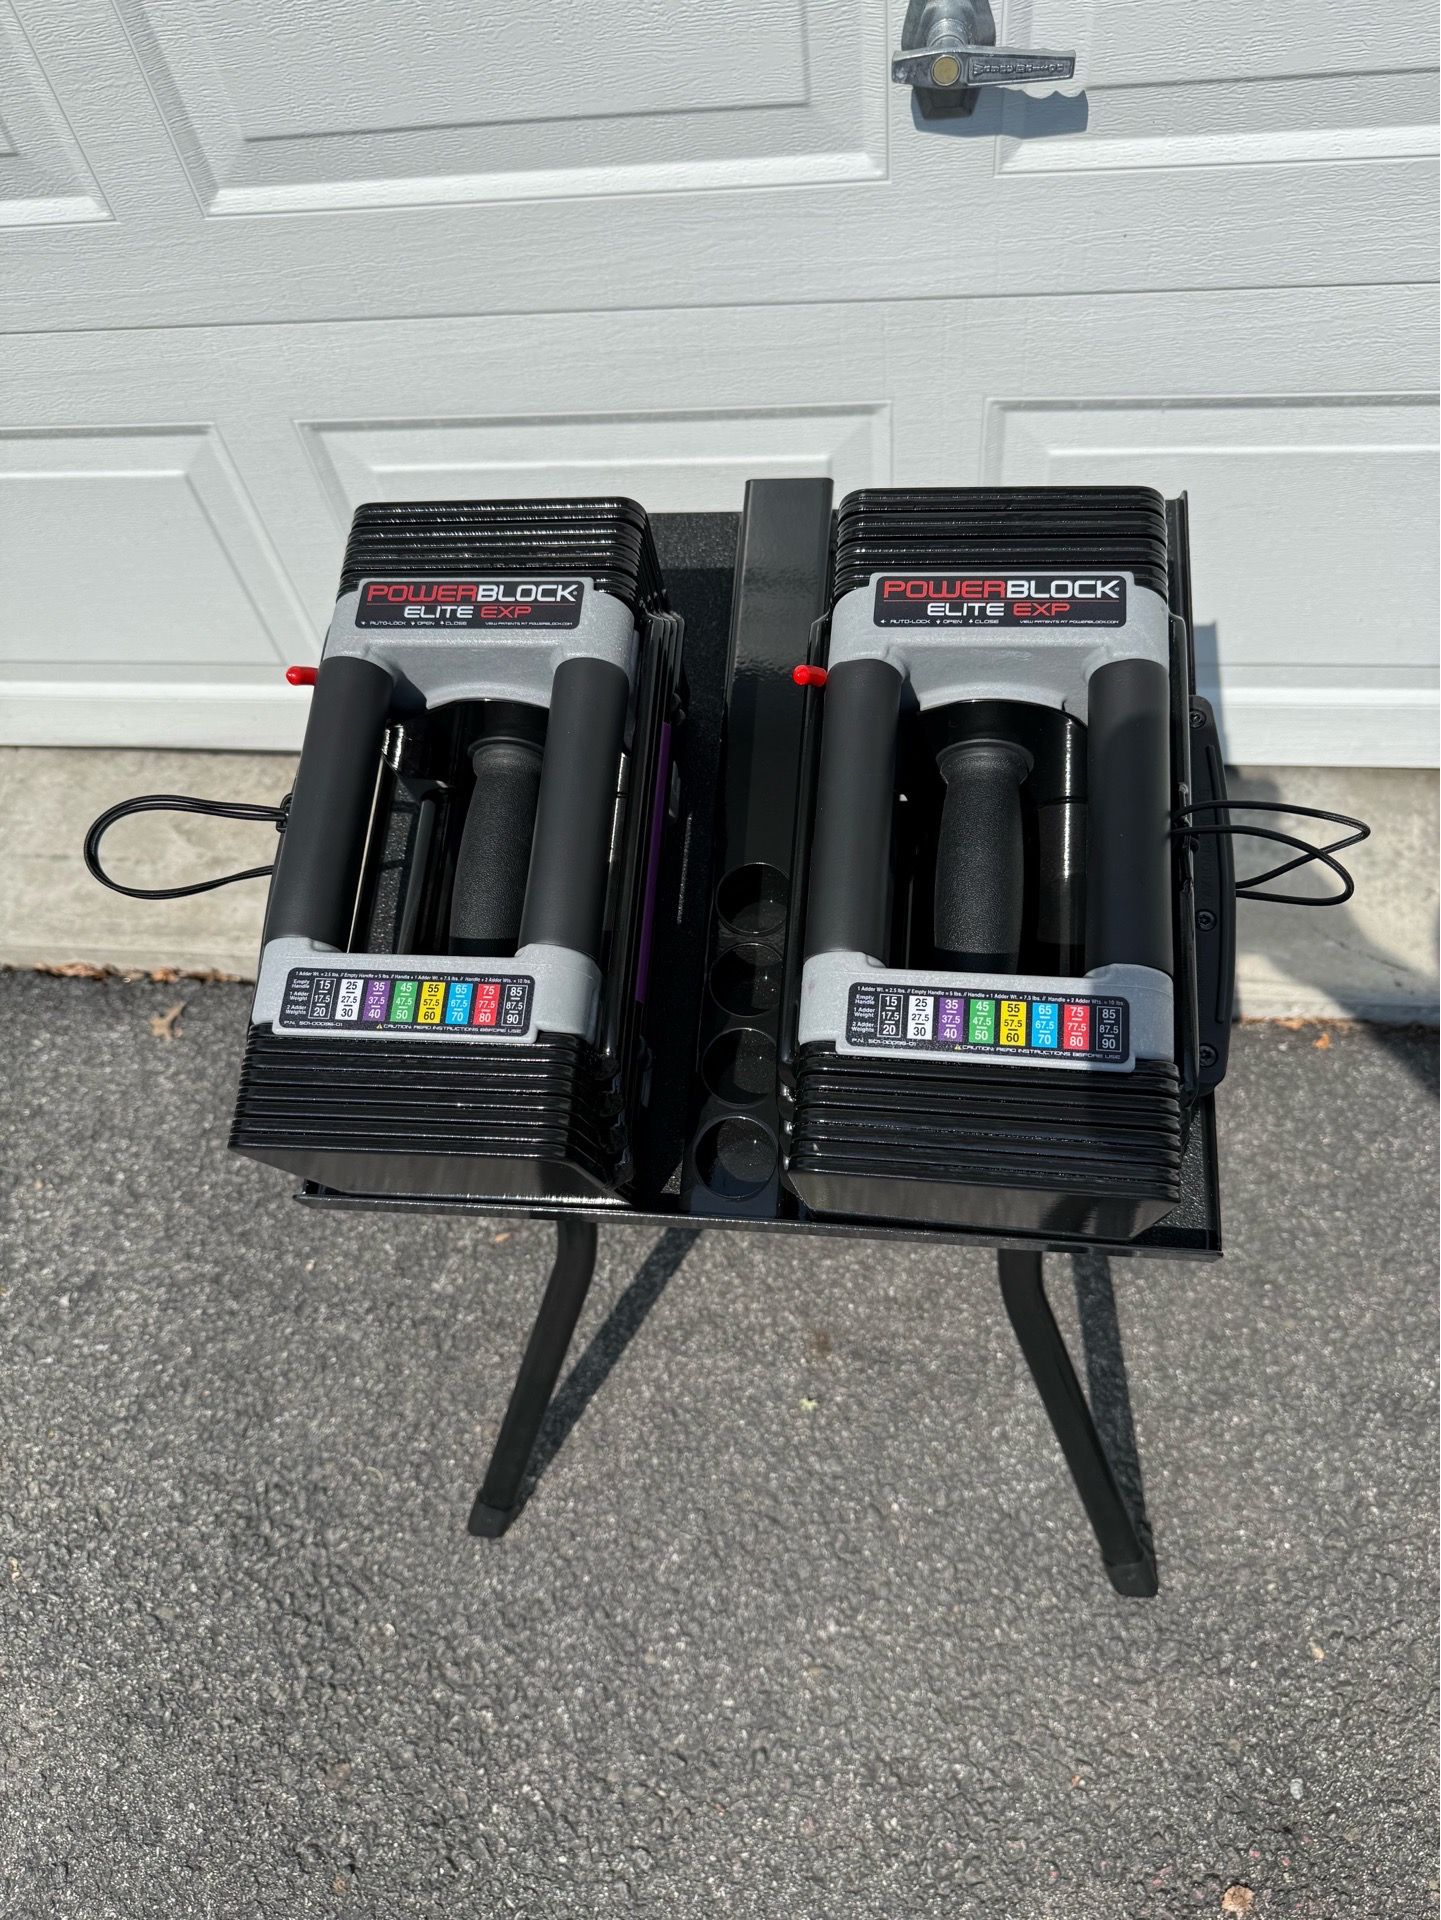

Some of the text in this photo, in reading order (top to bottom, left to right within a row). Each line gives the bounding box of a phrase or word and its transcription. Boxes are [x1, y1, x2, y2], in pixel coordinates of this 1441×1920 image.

[404, 606, 532, 619] ELITE EXP
[927, 603, 1070, 616] ELITE EXP
[320, 981, 522, 996] 15 25 35 45 55 65 75 85
[314, 995, 330, 1003] 17.5
[314, 1008, 519, 1023] 20 30 40 50 60 70 80 90
[885, 997, 1116, 1019] 15 25 35 45 55 65 75 85
[912, 1014, 929, 1022] 27.5
[942, 1015, 960, 1023] 37.5
[973, 1017, 991, 1025] 47.5
[1035, 1021, 1054, 1029] 67.5
[1067, 1023, 1086, 1031] 77.5
[1100, 1025, 1118, 1033] 87.5
[883, 1025, 1116, 1049] 20 30 40 50 60 70 80 90
